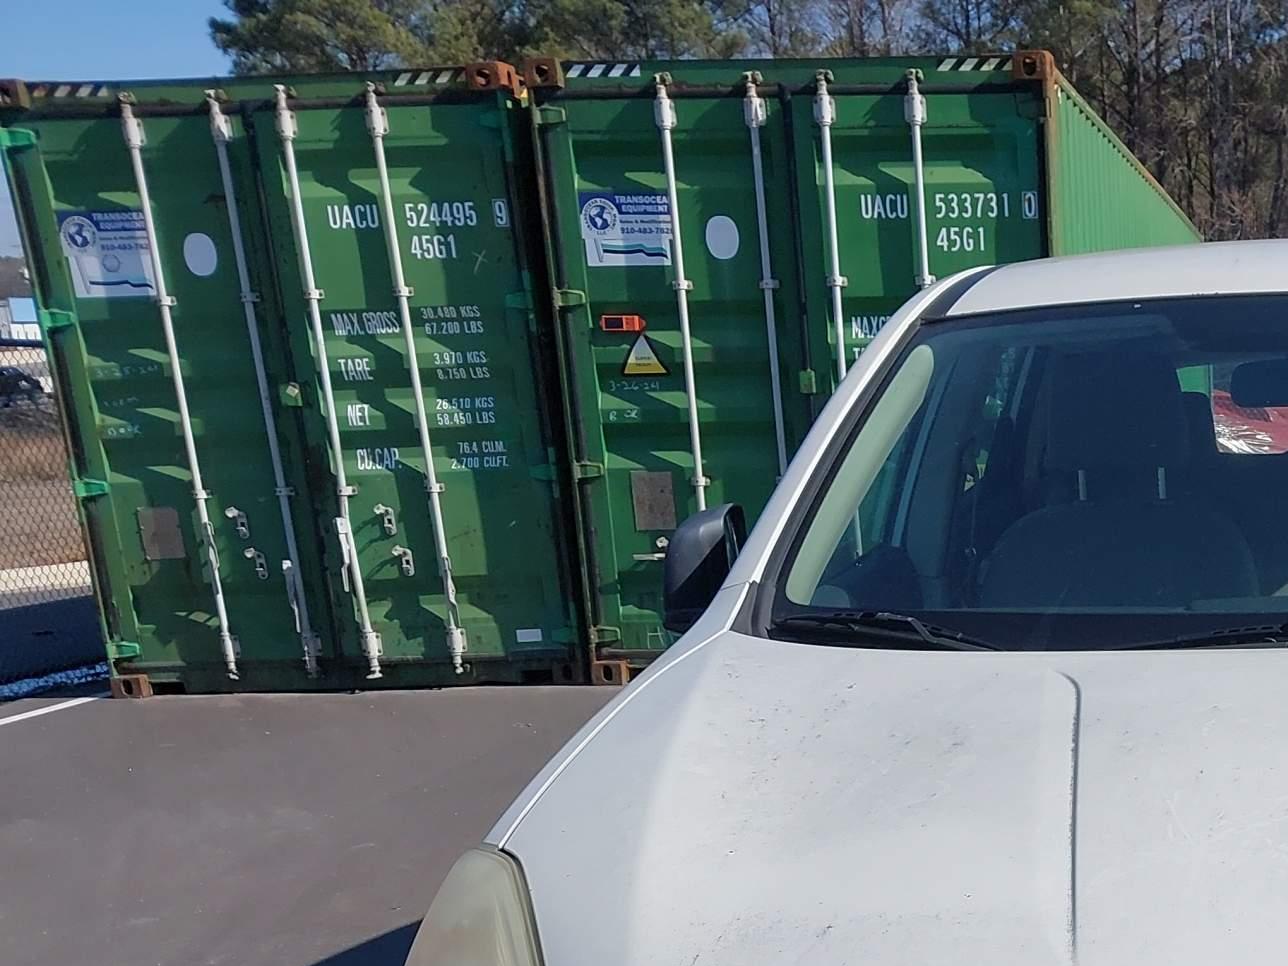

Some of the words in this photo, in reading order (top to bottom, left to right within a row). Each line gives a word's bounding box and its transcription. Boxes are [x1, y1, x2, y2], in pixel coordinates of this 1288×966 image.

[614, 195, 668, 204] TRANSOCEA
[860, 193, 908, 219] UACU
[935, 193, 1009, 219] 533731
[1023, 192, 1036, 218] 0
[327, 204, 379, 229] UACU
[404, 202, 477, 227] 524495
[494, 200, 508, 226] 9
[936, 226, 985, 251] 45G1
[411, 234, 457, 259] 45G1
[420, 307, 457, 319] 30.480
[459, 305, 481, 317] KGS
[362, 311, 400, 335] GROSS
[424, 322, 460, 335] 67.200
[463, 320, 484, 334] LBS
[433, 351, 463, 365] 3.970
[466, 350, 487, 363] KGS
[338, 357, 374, 381] TARE
[437, 368, 467, 380] 8.750
[469, 366, 490, 379] LBS
[436, 398, 471, 410] 26.510
[475, 396, 494, 409] KGS
[347, 404, 371, 426] NET
[437, 412, 472, 425] 58.450
[476, 411, 496, 424] LBS
[457, 441, 478, 454] 76.4
[451, 457, 480, 469] 2.700
